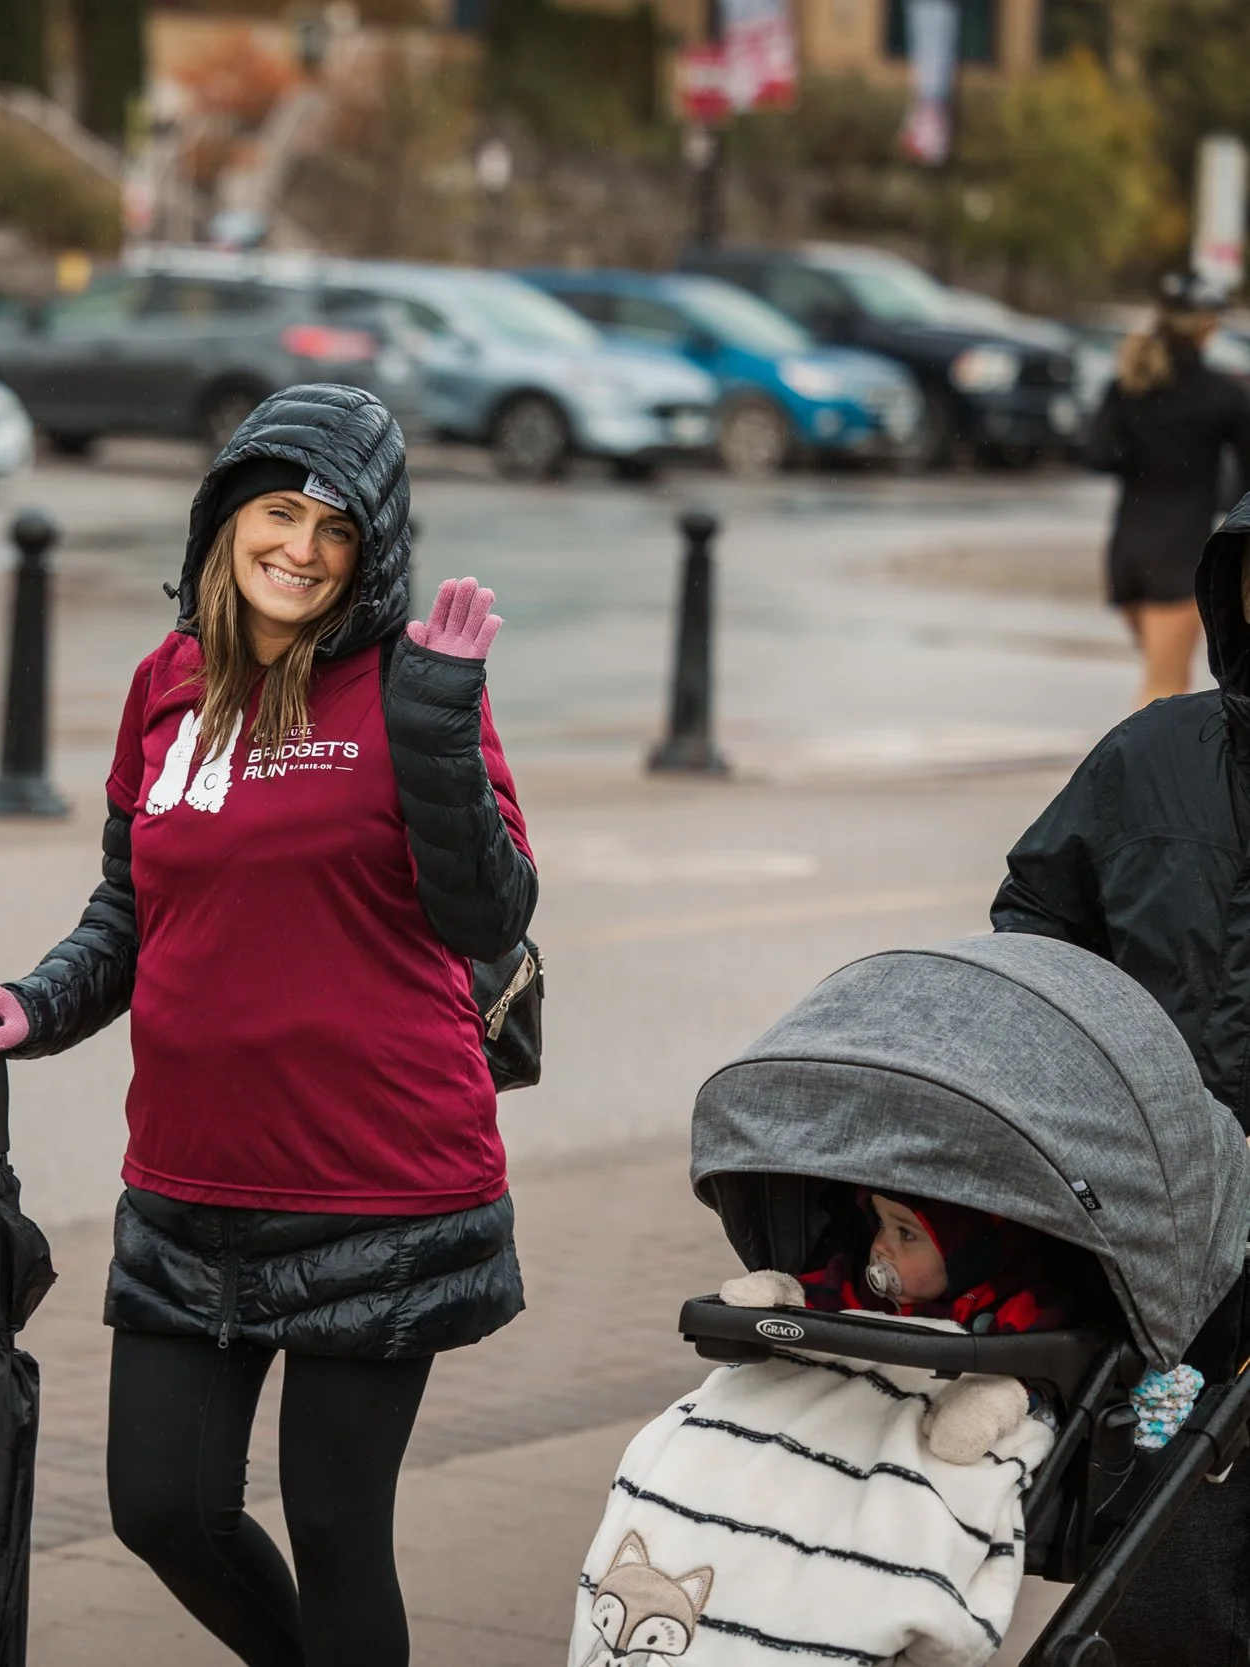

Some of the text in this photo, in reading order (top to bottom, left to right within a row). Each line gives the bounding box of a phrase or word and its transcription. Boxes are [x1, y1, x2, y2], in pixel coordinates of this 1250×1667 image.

[248, 741, 359, 763] BRIDGET'S
[242, 762, 288, 780] RUN
[1082, 1197, 1096, 1209] 50
[762, 1323, 800, 1338] GRACO
